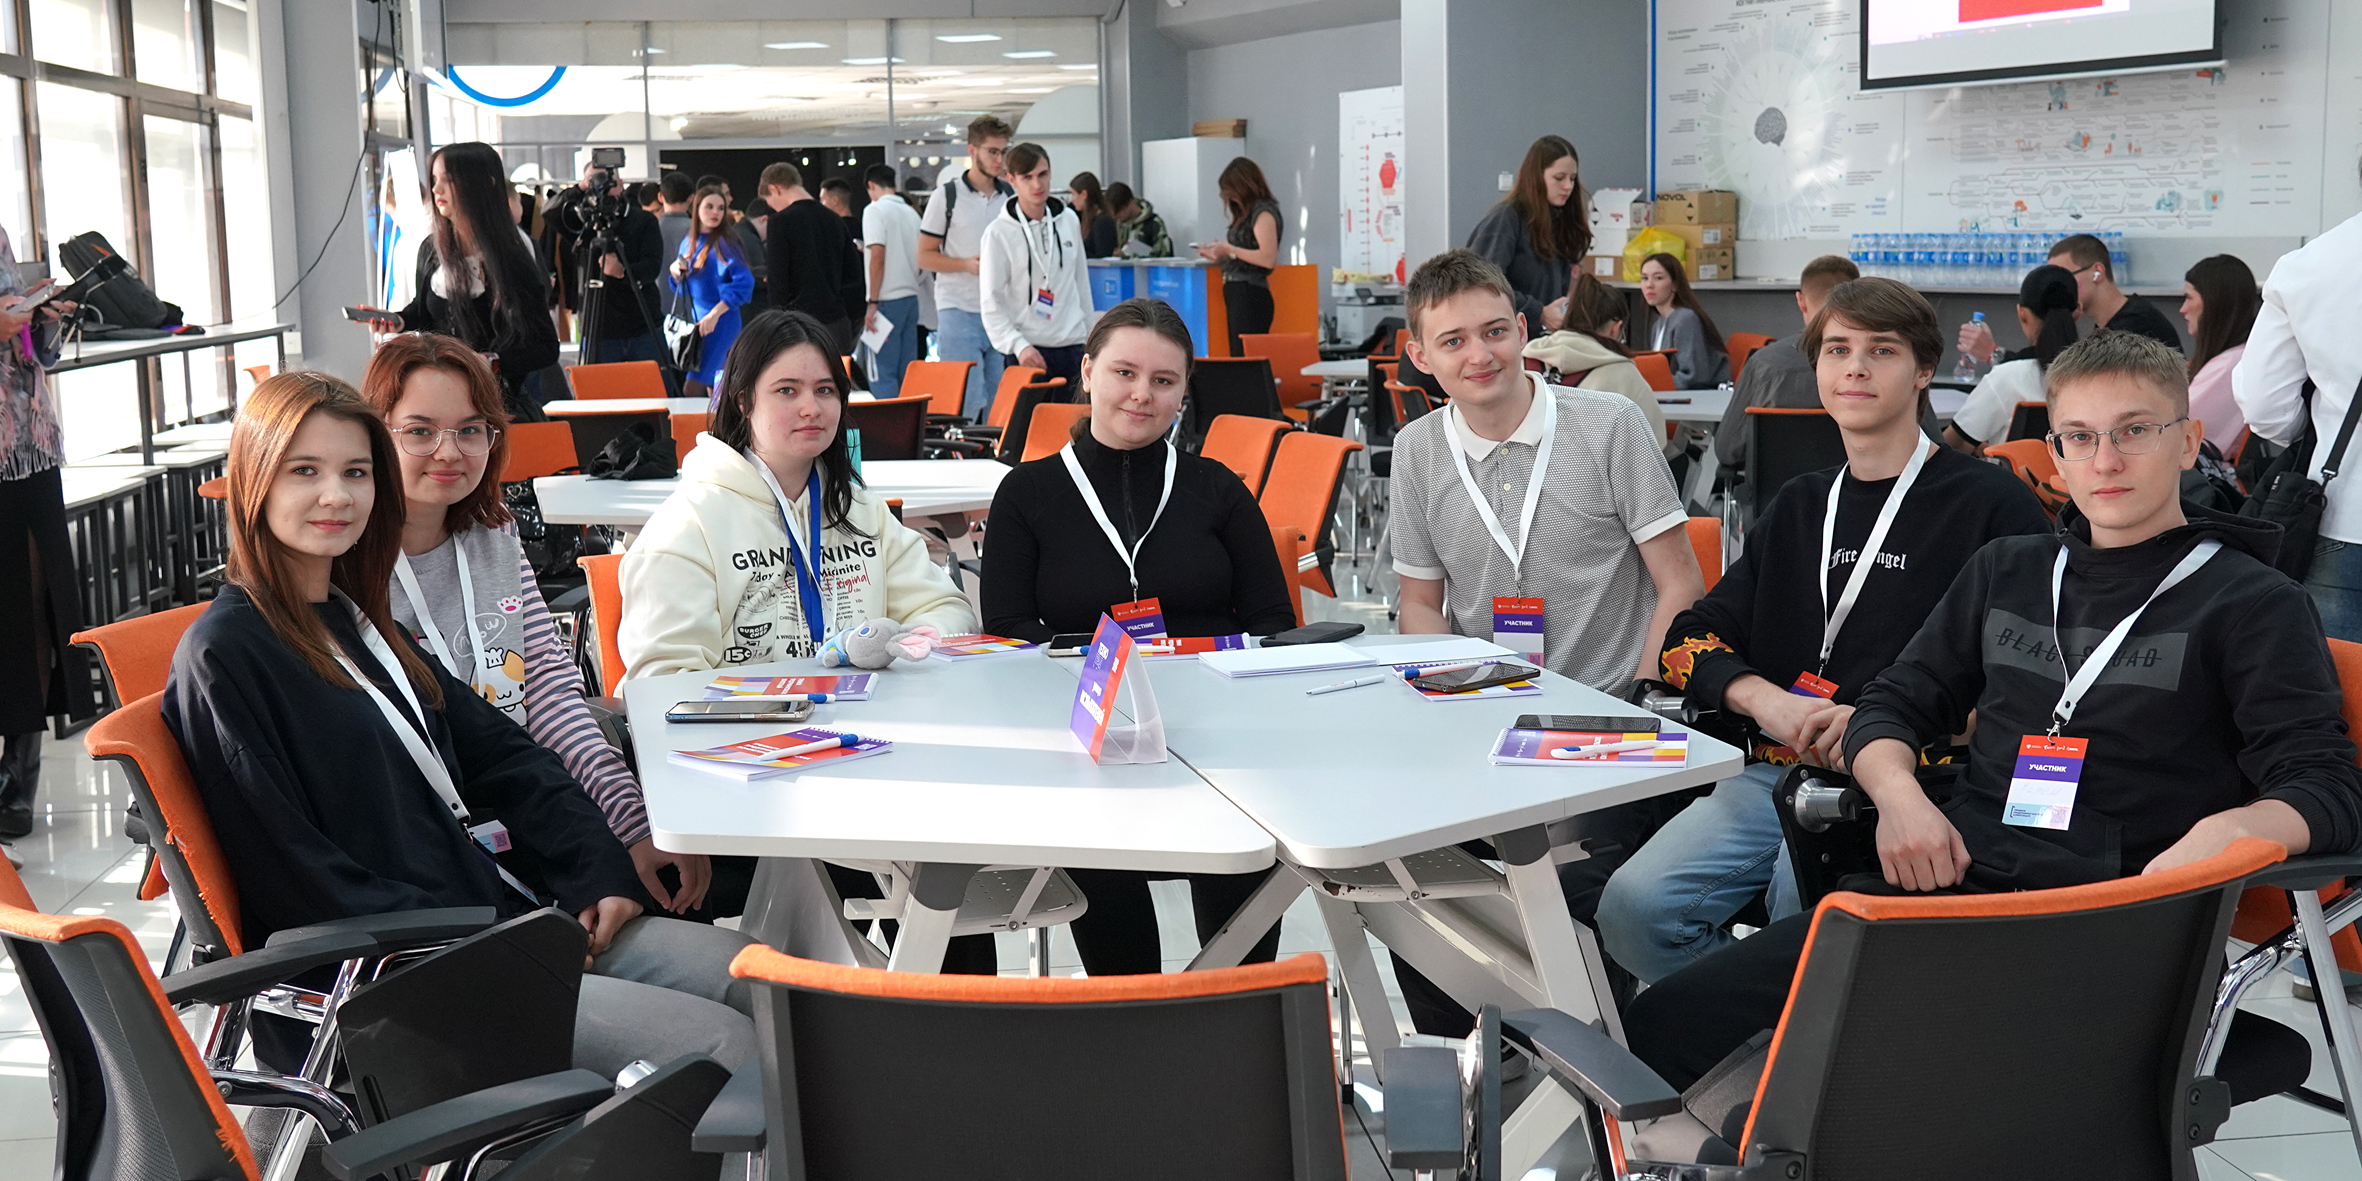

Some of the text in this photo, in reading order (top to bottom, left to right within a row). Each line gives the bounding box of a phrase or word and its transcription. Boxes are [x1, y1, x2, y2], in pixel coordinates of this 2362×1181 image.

[1828, 548, 1907, 570] Fire ngel
[460, 618, 499, 649] mow
[740, 624, 769, 634] BURGER
[1127, 622, 1155, 631] УЧАСТНИК
[2081, 646, 2158, 668] SUAD
[2029, 764, 2067, 772] УЧАСТНИК
